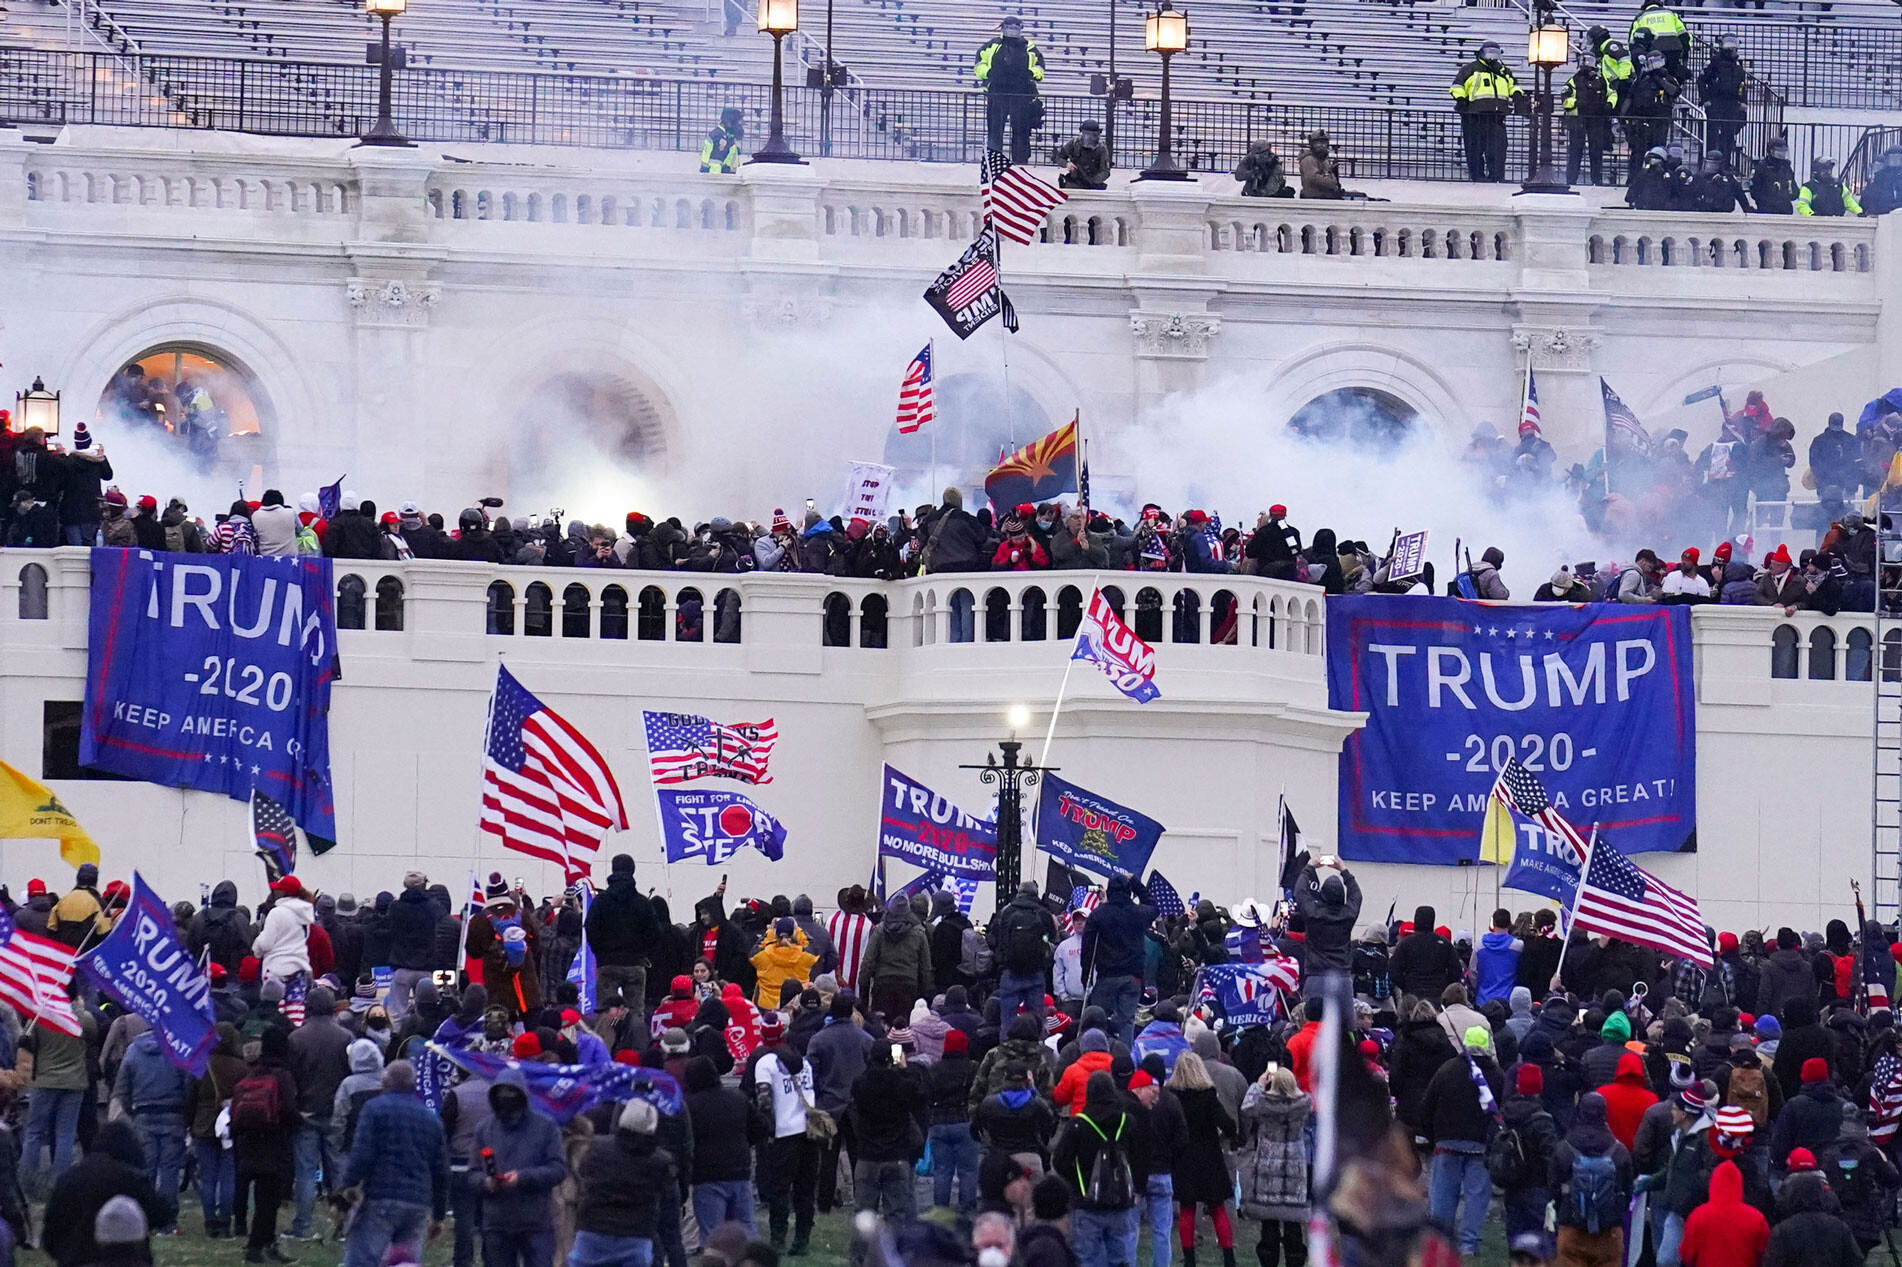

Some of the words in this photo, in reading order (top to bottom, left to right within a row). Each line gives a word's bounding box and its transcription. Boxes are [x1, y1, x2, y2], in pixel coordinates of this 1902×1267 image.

[1646, 16, 1665, 24] POLICE
[1406, 534, 1422, 572] TRUMP
[1368, 638, 1655, 711] TRUMP
[113, 700, 170, 730] KEEP
[668, 713, 705, 727] GOD
[1446, 732, 1596, 772] -2020-
[676, 795, 705, 804] FIGHT
[710, 795, 730, 803] FOR
[1371, 790, 1436, 811] KEEP
[1581, 779, 1675, 808] GREAT!
[1058, 794, 1136, 844] TRUMP
[883, 834, 902, 849] NO
[902, 840, 938, 860] MORE
[1052, 839, 1072, 854] KEEP
[1074, 852, 1112, 870] AMERICA
[1520, 857, 1544, 871] MAKE
[1561, 872, 1579, 889] GREA
